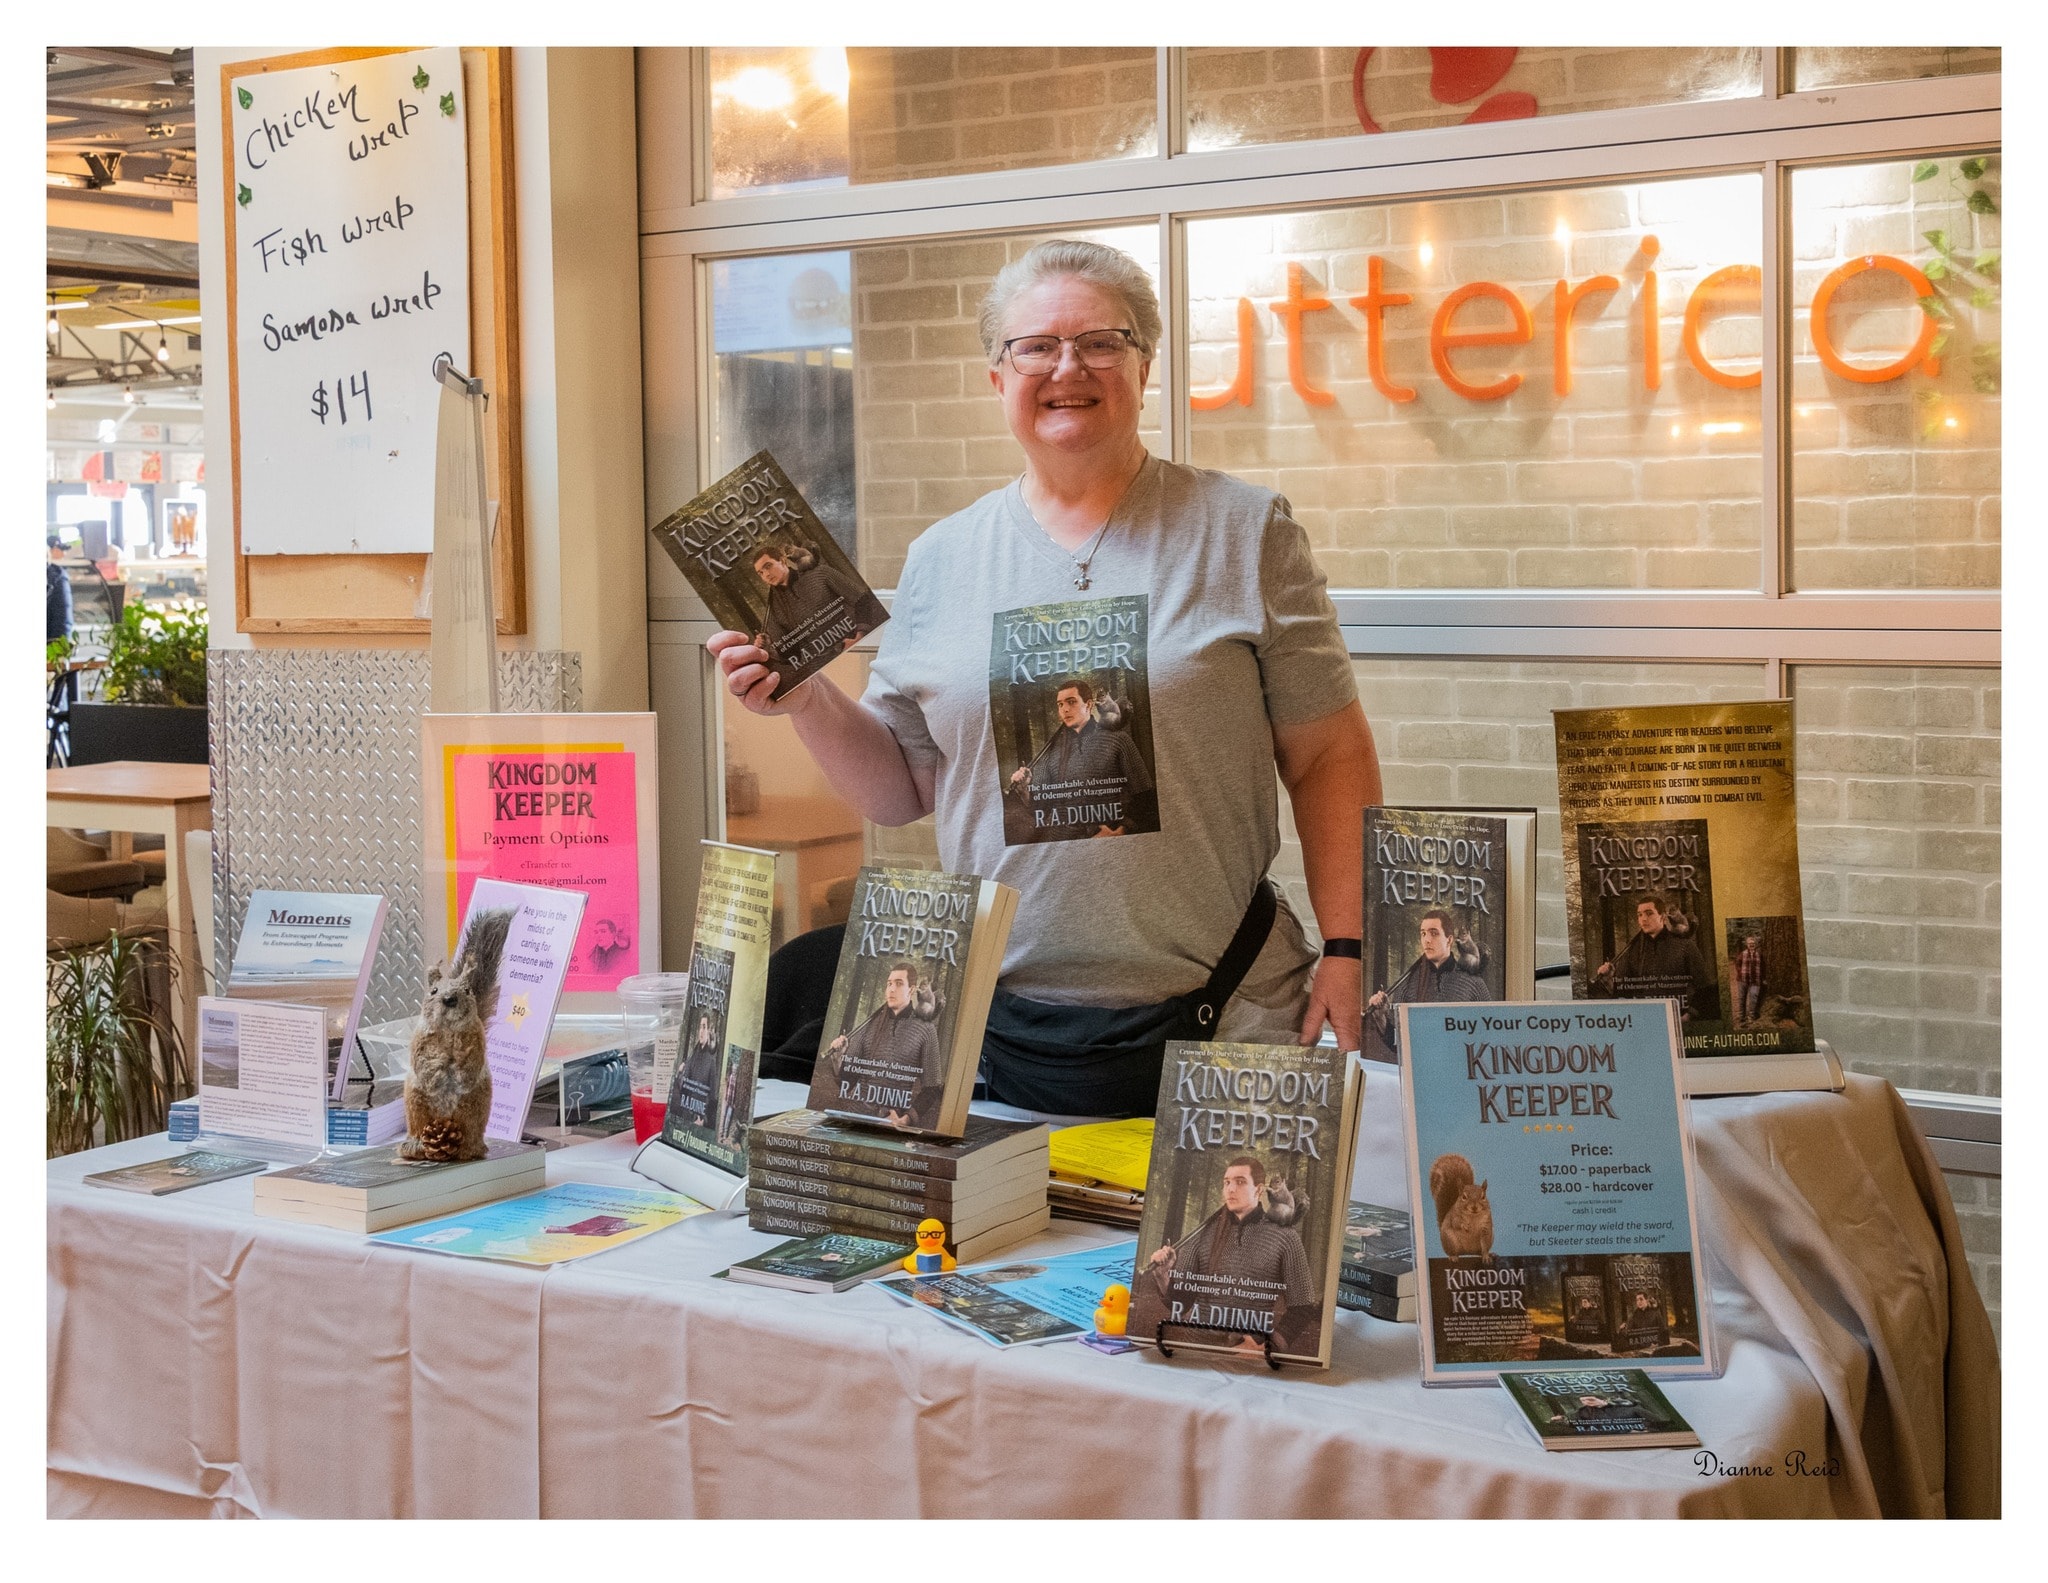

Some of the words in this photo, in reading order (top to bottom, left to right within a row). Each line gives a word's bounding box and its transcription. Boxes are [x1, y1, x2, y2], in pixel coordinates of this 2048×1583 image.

[245, 84, 370, 169] Chicken
[311, 370, 373, 425] $14
[670, 468, 782, 558] KINGDOM
[696, 498, 803, 581] KEEPER
[815, 616, 857, 655] DUNNE
[1002, 610, 1139, 652] KINGDOM
[1009, 642, 1136, 685] KEEPER
[1566, 732, 1576, 740] AN
[1598, 729, 1629, 739] FANTASY
[1632, 728, 1673, 738] ADVENTURE
[1675, 728, 1688, 736] FOR
[1691, 726, 1722, 736] READERS
[1725, 725, 1742, 735] WHO
[1745, 725, 1773, 734] BELIEVE
[1638, 761, 1696, 771] COMING-OF-AGE
[1698, 760, 1721, 769] STORY
[1723, 760, 1737, 769] FOR
[1747, 758, 1786, 768] RELUCTANT
[487, 761, 597, 790] KINGDOM
[1027, 783, 1040, 792] The
[1042, 780, 1084, 790] Remarkable
[1086, 776, 1128, 786] Adventures
[1610, 780, 1651, 790] MANIFESTS
[1653, 780, 1666, 788] HIS
[1669, 778, 1699, 788] DESTINY
[1702, 777, 1749, 786] SURROUNDED
[1751, 776, 1761, 785] BY
[1033, 792, 1041, 801] of
[1042, 790, 1073, 801] Odemog
[1074, 788, 1082, 797] of
[1083, 786, 1122, 797] Mazgamor
[1603, 799, 1613, 807] AS
[1615, 797, 1632, 806] THEY
[1635, 796, 1657, 806] UNITE
[1666, 794, 1701, 804] KINGDOM
[1703, 794, 1712, 802] TO
[1715, 793, 1744, 802] COMBAT
[495, 791, 597, 821] KEEPER
[1067, 802, 1125, 825] DUNNE
[484, 832, 545, 852] Payment
[550, 831, 609, 849] Options
[1373, 828, 1493, 871] KINGDOM
[1589, 834, 1699, 866] KINGDOM
[520, 861, 558, 870] eTransfer
[1381, 868, 1490, 915] KEEPER
[1598, 865, 1700, 898] KEEPER
[859, 882, 971, 923] KINGDOM
[267, 909, 352, 926] Moments
[523, 906, 534, 916] Are
[534, 909, 547, 920] you
[548, 909, 555, 919] in
[556, 911, 567, 922] the
[527, 923, 545, 935] midst
[546, 926, 555, 936] of
[520, 940, 539, 952] caring
[541, 941, 551, 951] for
[857, 921, 959, 966] KEEPER
[510, 954, 538, 968] someone
[539, 958, 554, 969] with
[510, 968, 544, 984] dementia?
[512, 1004, 526, 1018] $40
[1444, 1017, 1478, 1034] Buy
[1482, 1016, 1522, 1031] Your
[1526, 1015, 1571, 1033] Copy
[1575, 1014, 1632, 1030] Today!
[1464, 1042, 1618, 1081] KINGDOM
[1173, 1060, 1332, 1108] KINGDOM
[866, 1084, 913, 1109] DUNNE
[1477, 1083, 1621, 1124] KEEPER
[1174, 1106, 1321, 1161] KEEPER
[765, 1134, 798, 1149] KINGDOM
[800, 1140, 831, 1156] KEEPER
[1571, 1143, 1613, 1156] Price:
[766, 1154, 798, 1168] KINGDOM
[800, 1160, 830, 1176] KEEPER
[906, 1159, 929, 1172] DUNNE
[1539, 1164, 1577, 1176] $17.00
[1588, 1163, 1651, 1177] paperback
[765, 1175, 797, 1190] KINGDOM
[799, 1180, 829, 1196] KEEPER
[904, 1179, 926, 1192] DUNNE
[1540, 1182, 1582, 1194] $28.00
[1593, 1181, 1653, 1192] hardcover
[763, 1196, 796, 1211] KINGDOM
[798, 1201, 827, 1218] KEEPER
[903, 1201, 925, 1214] DUNNE
[766, 1215, 799, 1230] KINGDOM
[1541, 1223, 1574, 1233] Keeper
[1577, 1224, 1597, 1233] may
[1599, 1221, 1624, 1230] wield
[1626, 1221, 1641, 1230] the
[1644, 1221, 1674, 1231] sword,
[1529, 1238, 1545, 1246] but
[1548, 1237, 1583, 1246] Skeeter
[1586, 1236, 1613, 1245] steals
[1616, 1236, 1631, 1244] the
[1168, 1270, 1184, 1279] The
[1186, 1271, 1237, 1284] Remarkable
[1238, 1277, 1287, 1290] Adventures
[1445, 1268, 1526, 1291] KINGDOM
[1173, 1282, 1183, 1290] of
[1185, 1283, 1220, 1296] Odemog
[1222, 1287, 1232, 1295] of
[1233, 1288, 1279, 1300] Mazgamor
[1452, 1289, 1527, 1314] KEEPER
[1210, 1305, 1275, 1333] DUNNE
[1522, 1373, 1629, 1387] KINGDOM
[1535, 1382, 1635, 1396] KEEPER
